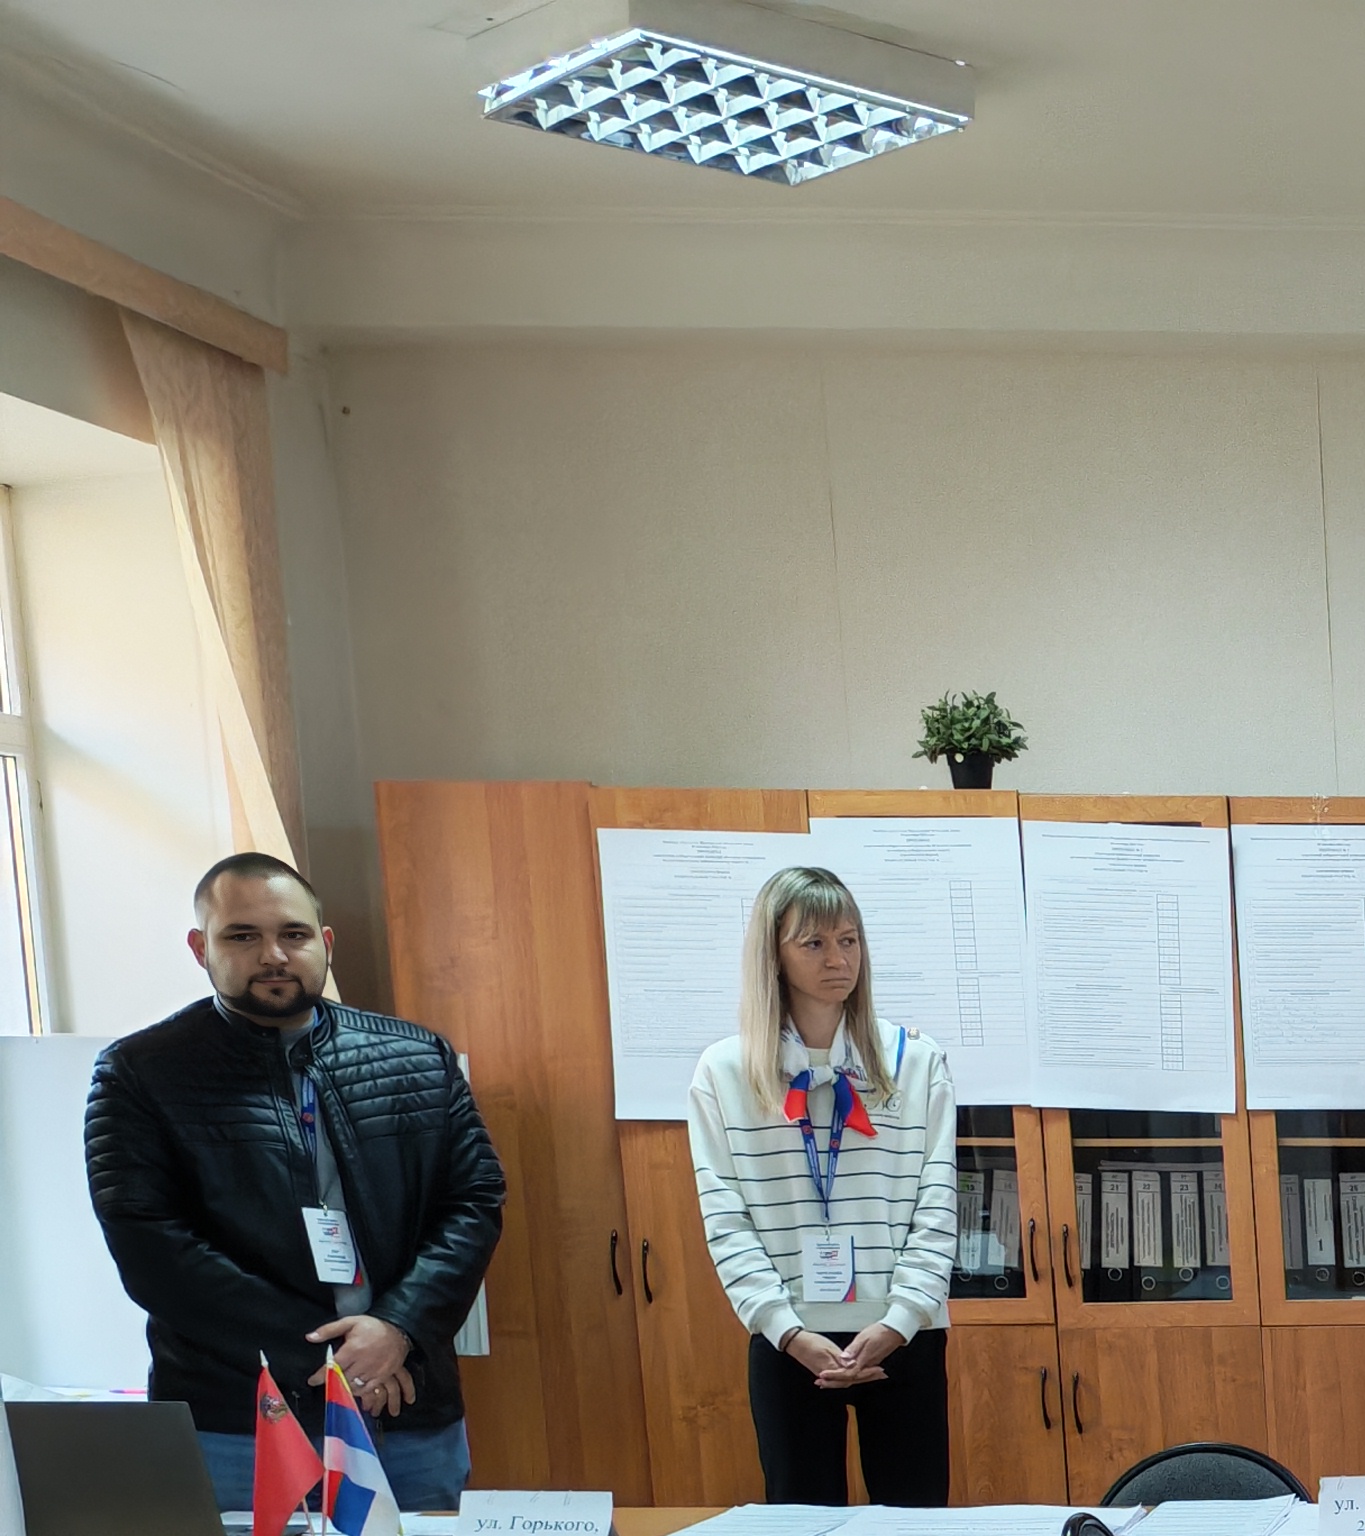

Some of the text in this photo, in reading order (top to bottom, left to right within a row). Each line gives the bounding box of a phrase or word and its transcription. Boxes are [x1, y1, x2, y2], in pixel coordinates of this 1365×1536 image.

[1334, 1497, 1359, 1514] ул.
[474, 1516, 599, 1534] ул. Горького,
